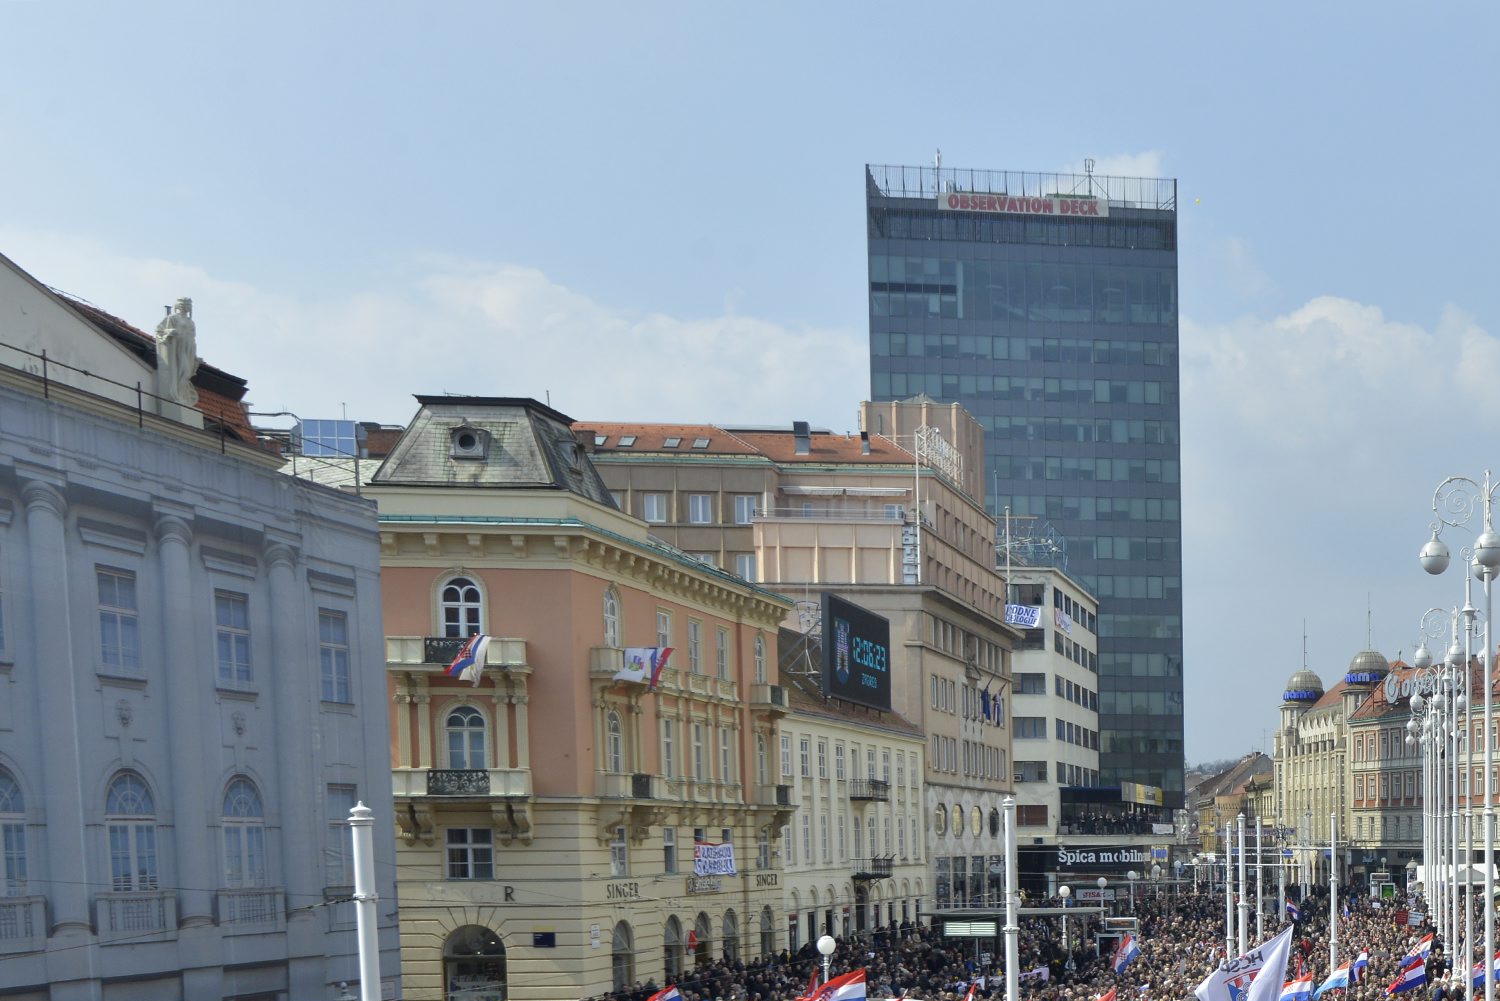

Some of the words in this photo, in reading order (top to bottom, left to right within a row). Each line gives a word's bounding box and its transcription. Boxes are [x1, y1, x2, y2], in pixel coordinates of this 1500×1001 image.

[948, 193, 1054, 214] OBSERVATION
[1059, 199, 1099, 216] DECK
[1058, 848, 1096, 865] Špica
[756, 873, 778, 887] SINGER
[606, 882, 640, 899] SINGER
